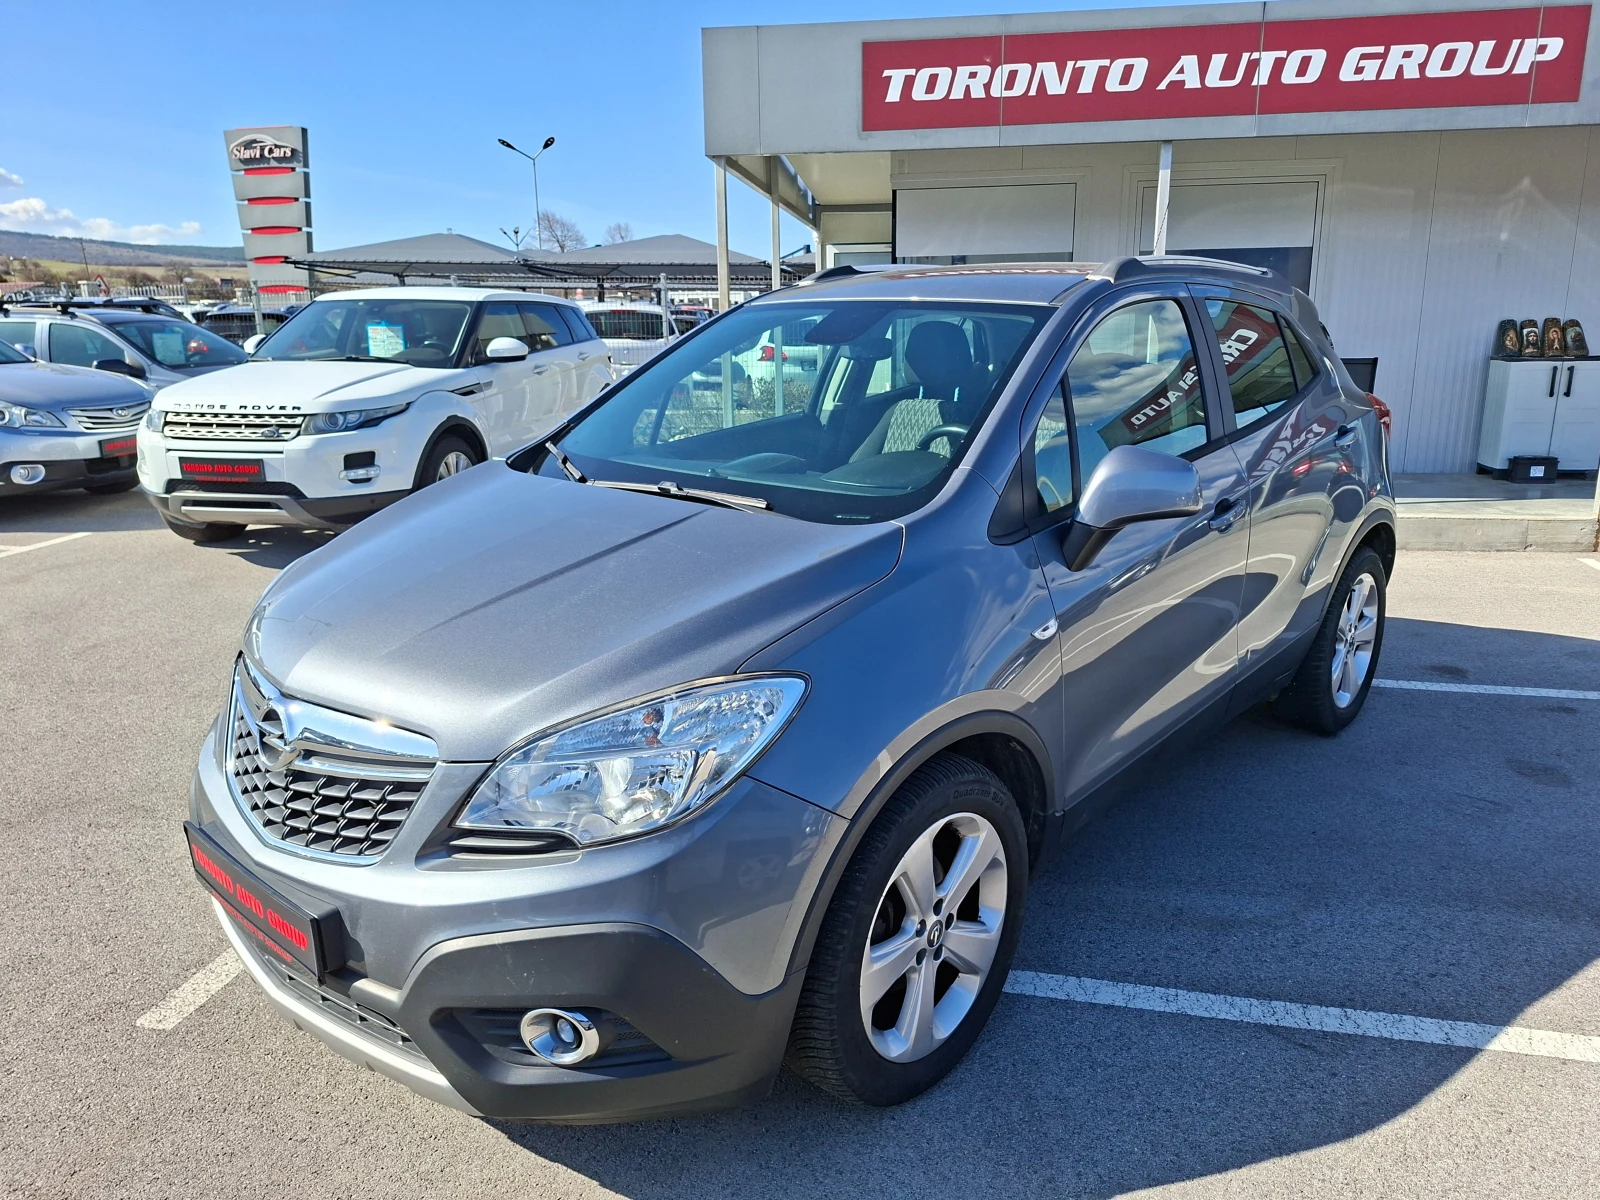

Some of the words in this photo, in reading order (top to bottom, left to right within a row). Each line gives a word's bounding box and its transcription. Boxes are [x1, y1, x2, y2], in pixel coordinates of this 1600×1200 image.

[882, 57, 1149, 102] TORONTO
[1156, 49, 1327, 91] AUTO
[1338, 37, 1565, 82] GROUP
[232, 146, 261, 160] Slavi
[263, 145, 292, 158] Cars
[182, 463, 213, 472] TORONTO
[214, 464, 233, 473] AUTO
[234, 465, 260, 474] GROUP
[991, 791, 1006, 807] SUV
[191, 843, 234, 894] TORONTO
[236, 883, 264, 919] AUTO
[267, 908, 308, 951] GROUP
